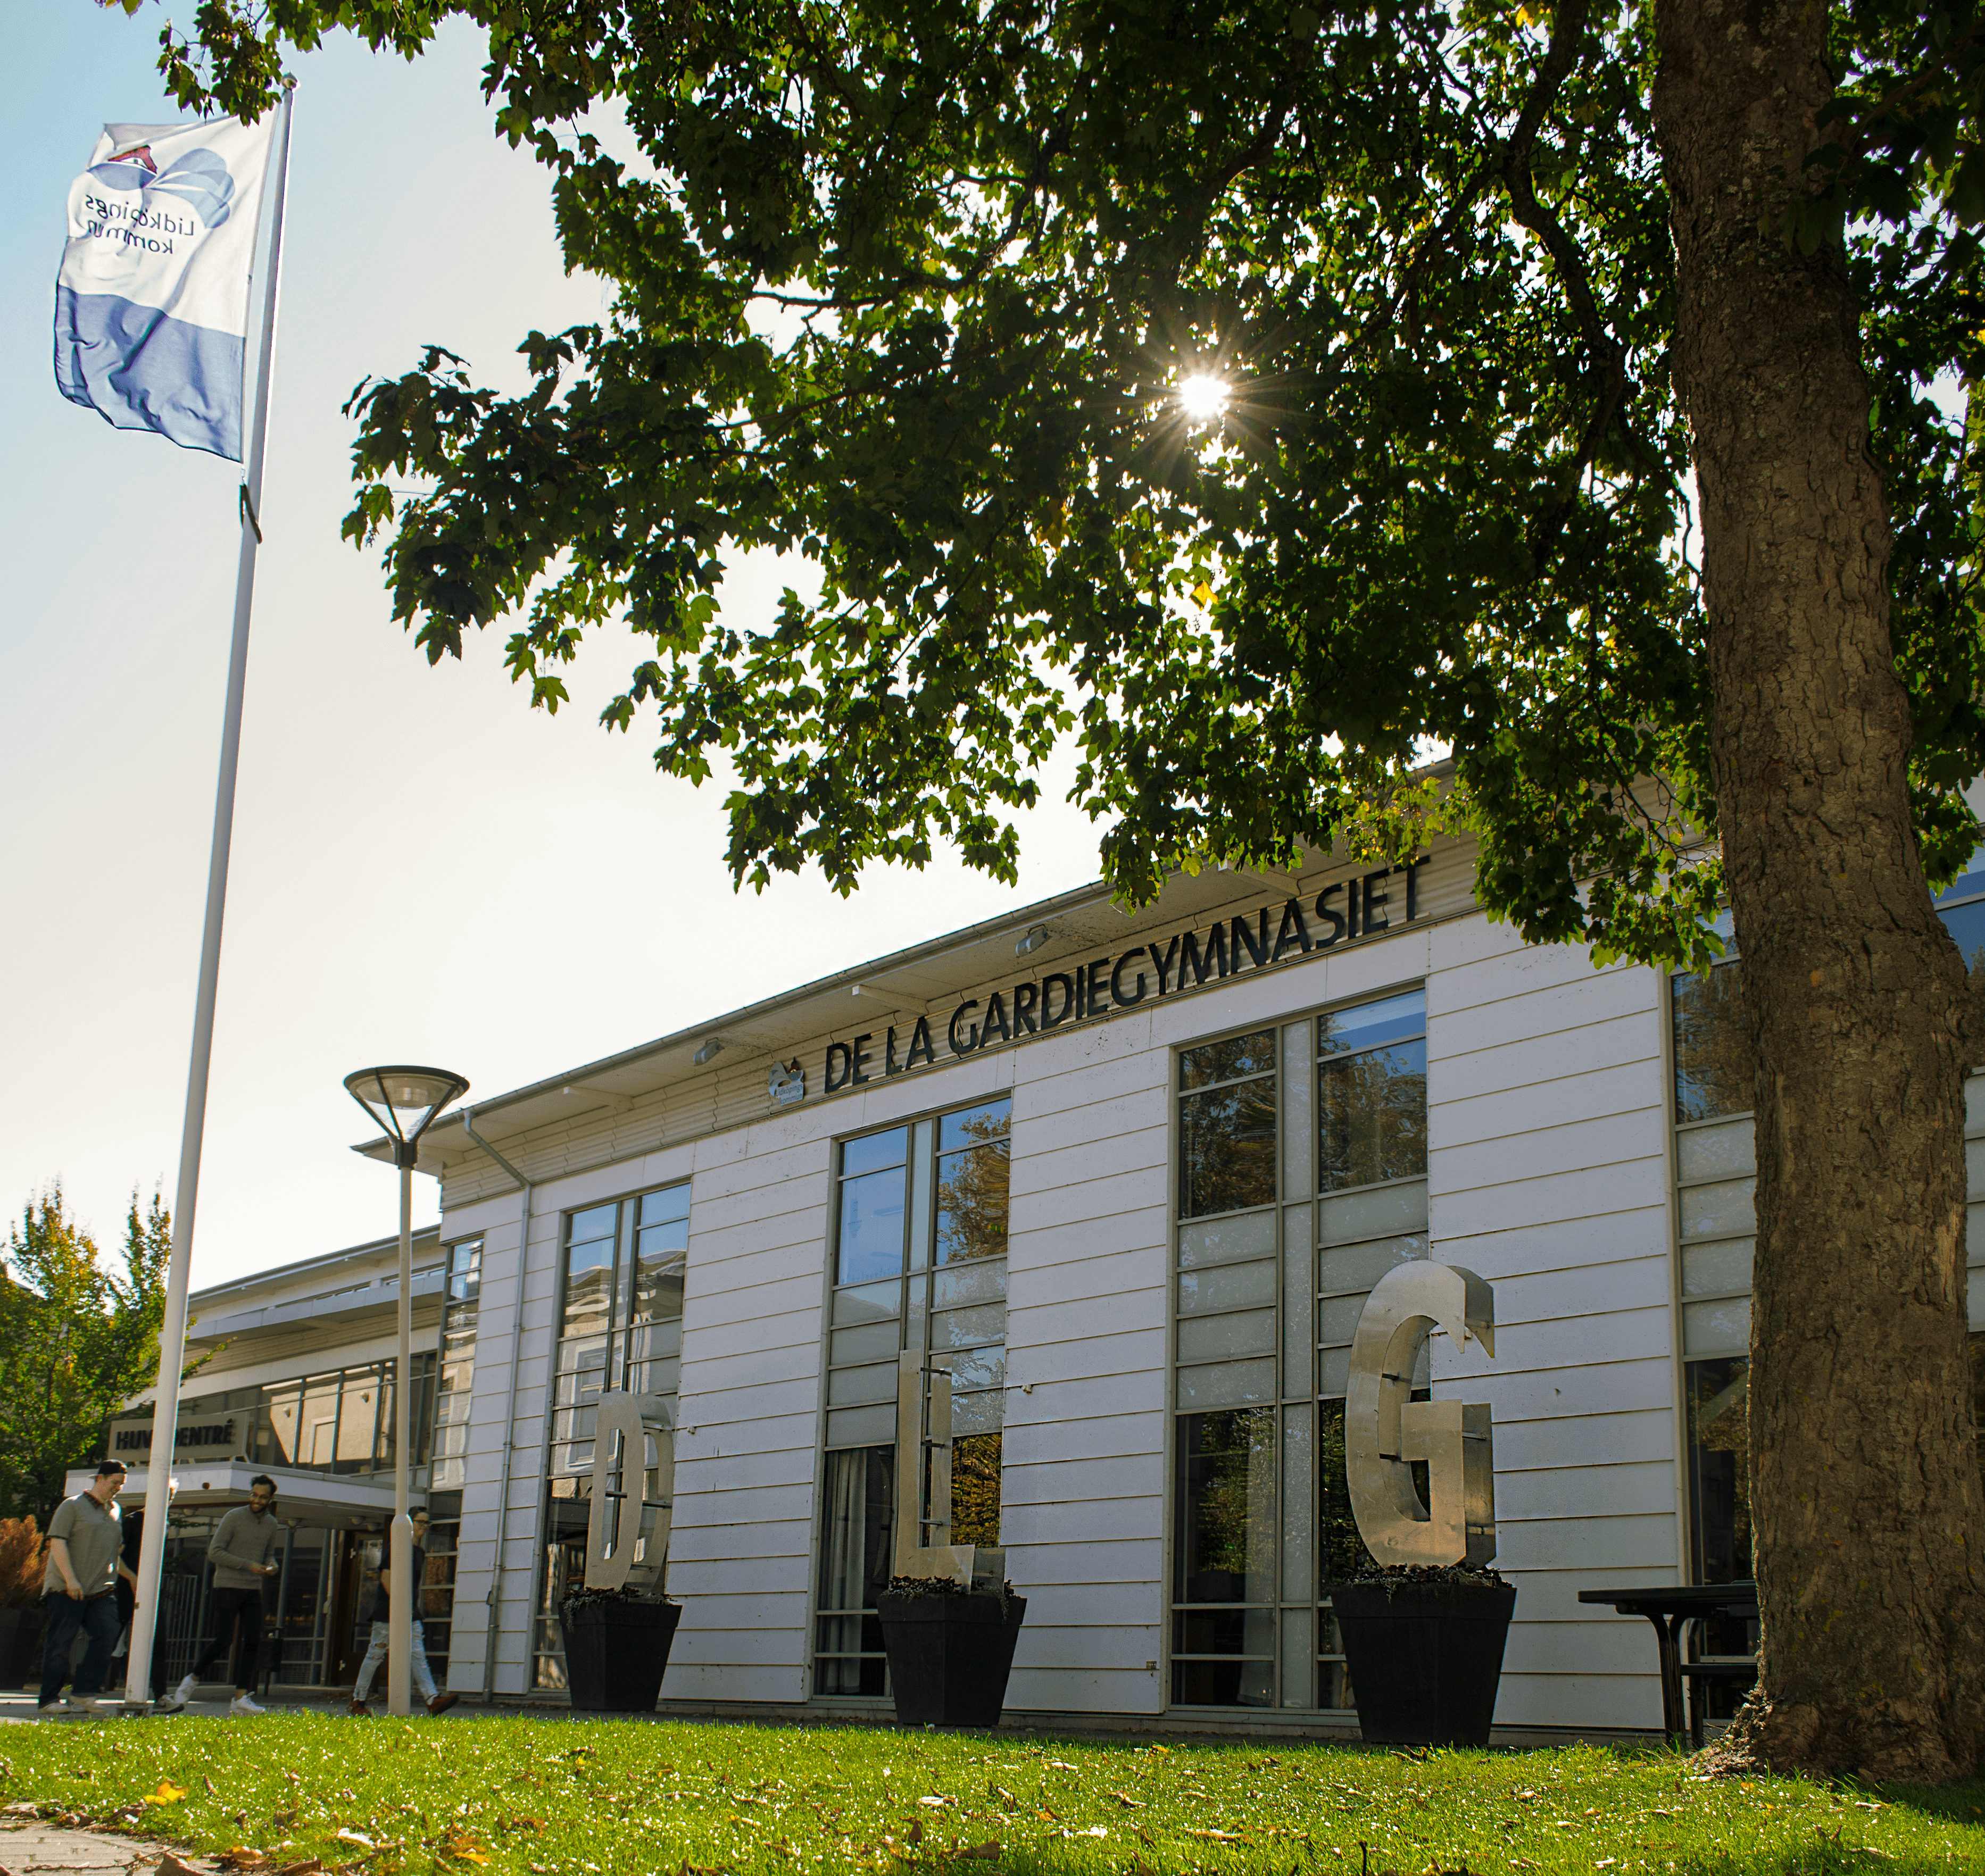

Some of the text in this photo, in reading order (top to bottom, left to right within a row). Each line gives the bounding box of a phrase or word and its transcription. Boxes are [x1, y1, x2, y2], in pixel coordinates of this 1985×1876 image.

[825, 855, 1430, 1094] DE LA GARDIEGYMNASIET
[115, 1418, 233, 1450] HUVENTRÉ
[1344, 1259, 1496, 1571] G
